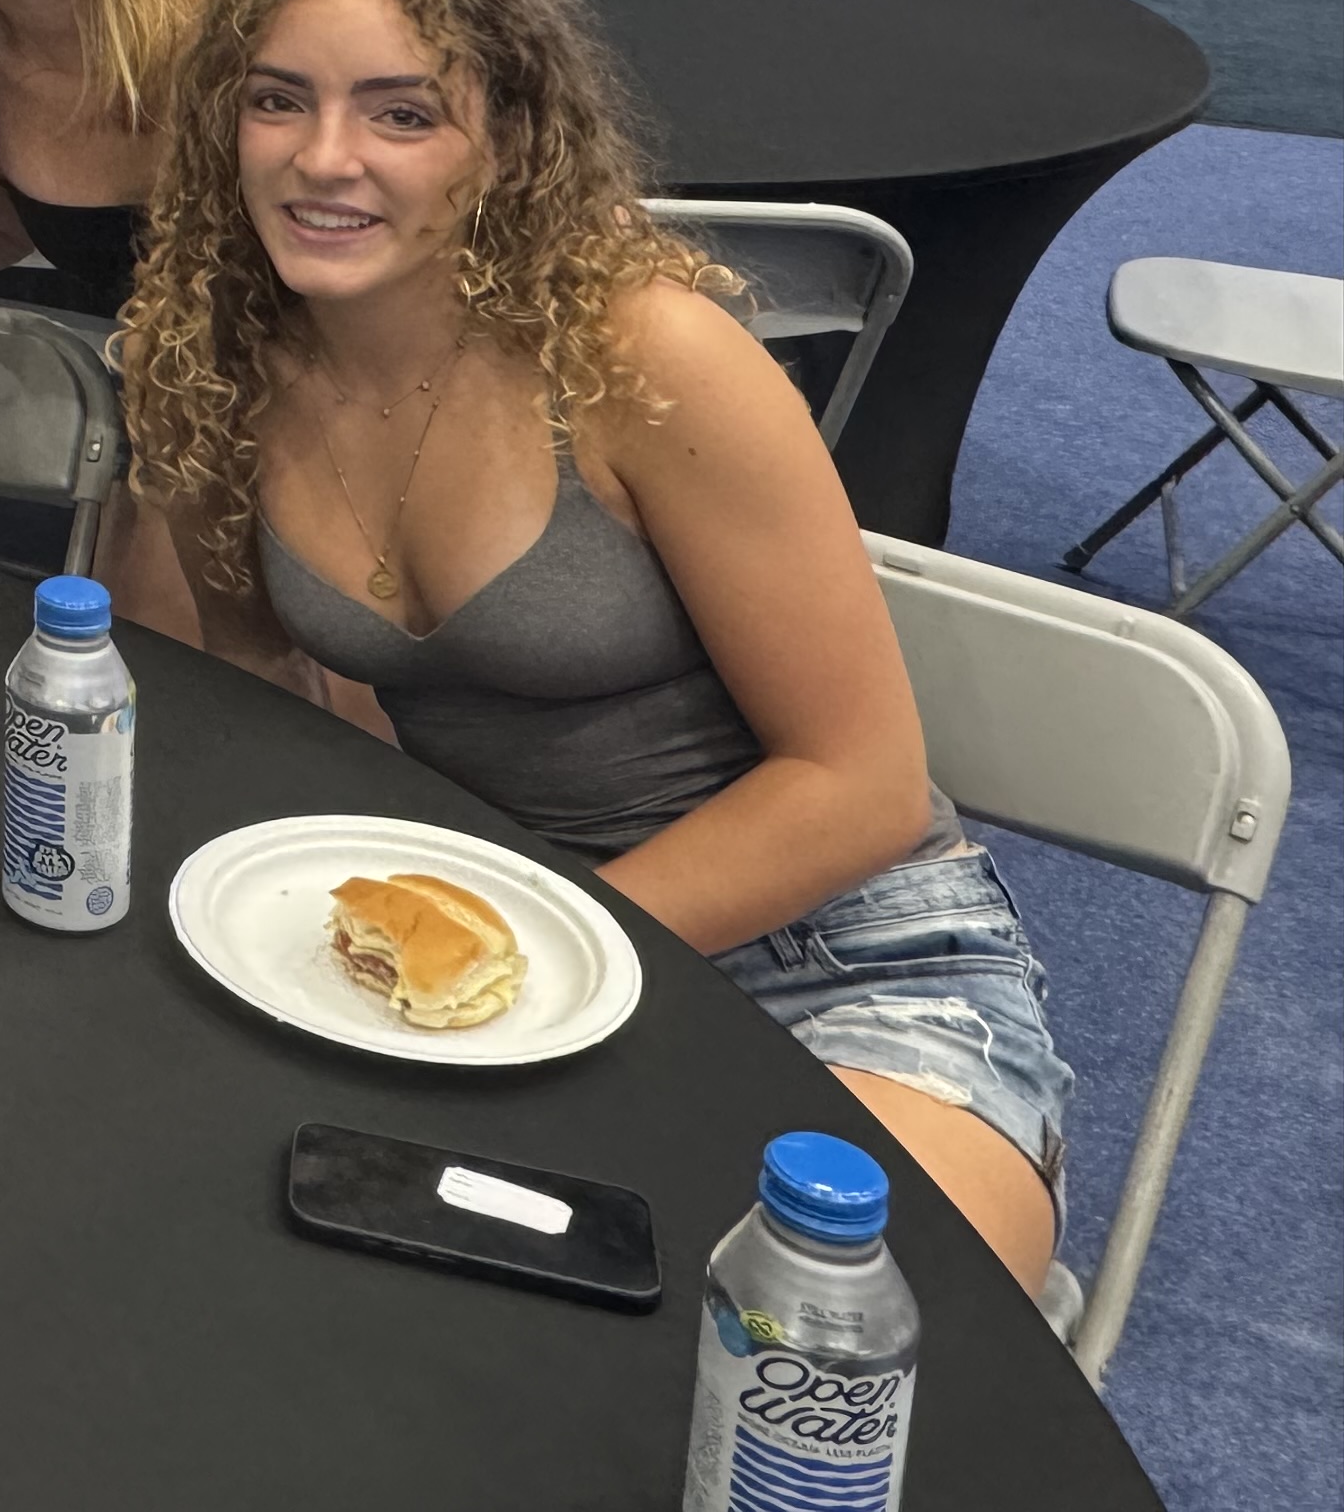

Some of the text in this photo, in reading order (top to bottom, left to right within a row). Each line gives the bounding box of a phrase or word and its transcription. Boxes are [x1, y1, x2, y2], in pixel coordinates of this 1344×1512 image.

[5, 728, 68, 772] ater
[755, 1356, 901, 1407] Open
[738, 1386, 899, 1445] Water
